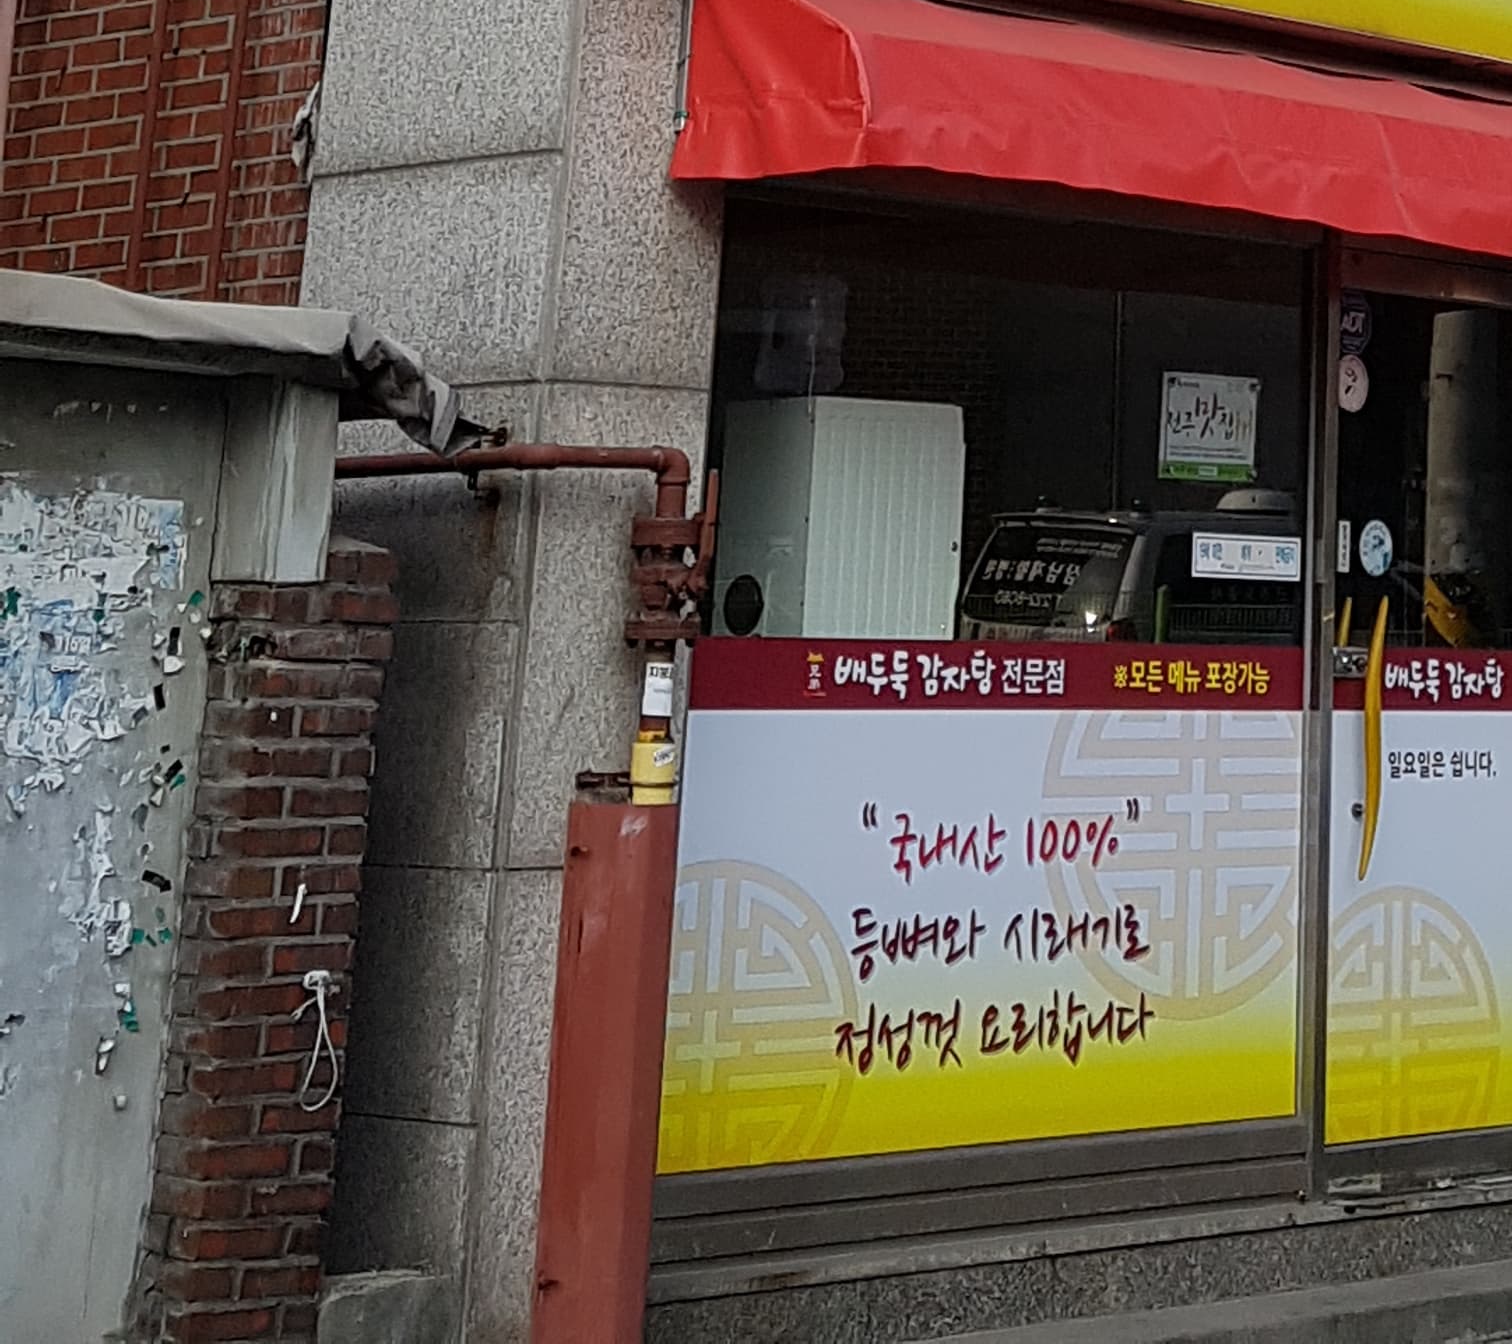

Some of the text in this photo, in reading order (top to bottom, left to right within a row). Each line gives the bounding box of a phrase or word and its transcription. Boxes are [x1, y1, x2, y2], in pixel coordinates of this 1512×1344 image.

[834, 649, 1065, 699] 배두둑 감자탕 전문점
[1168, 660, 1202, 693] 메뉴
[1205, 660, 1271, 694] 포장가능
[1385, 658, 1505, 703] 배두둑 감자탕
[1387, 750, 1497, 779] 일요일은 쉽니다.
[850, 903, 1151, 984] 등뼈와 시래기로
[834, 988, 1155, 1076] 정성껏 요리합니다
